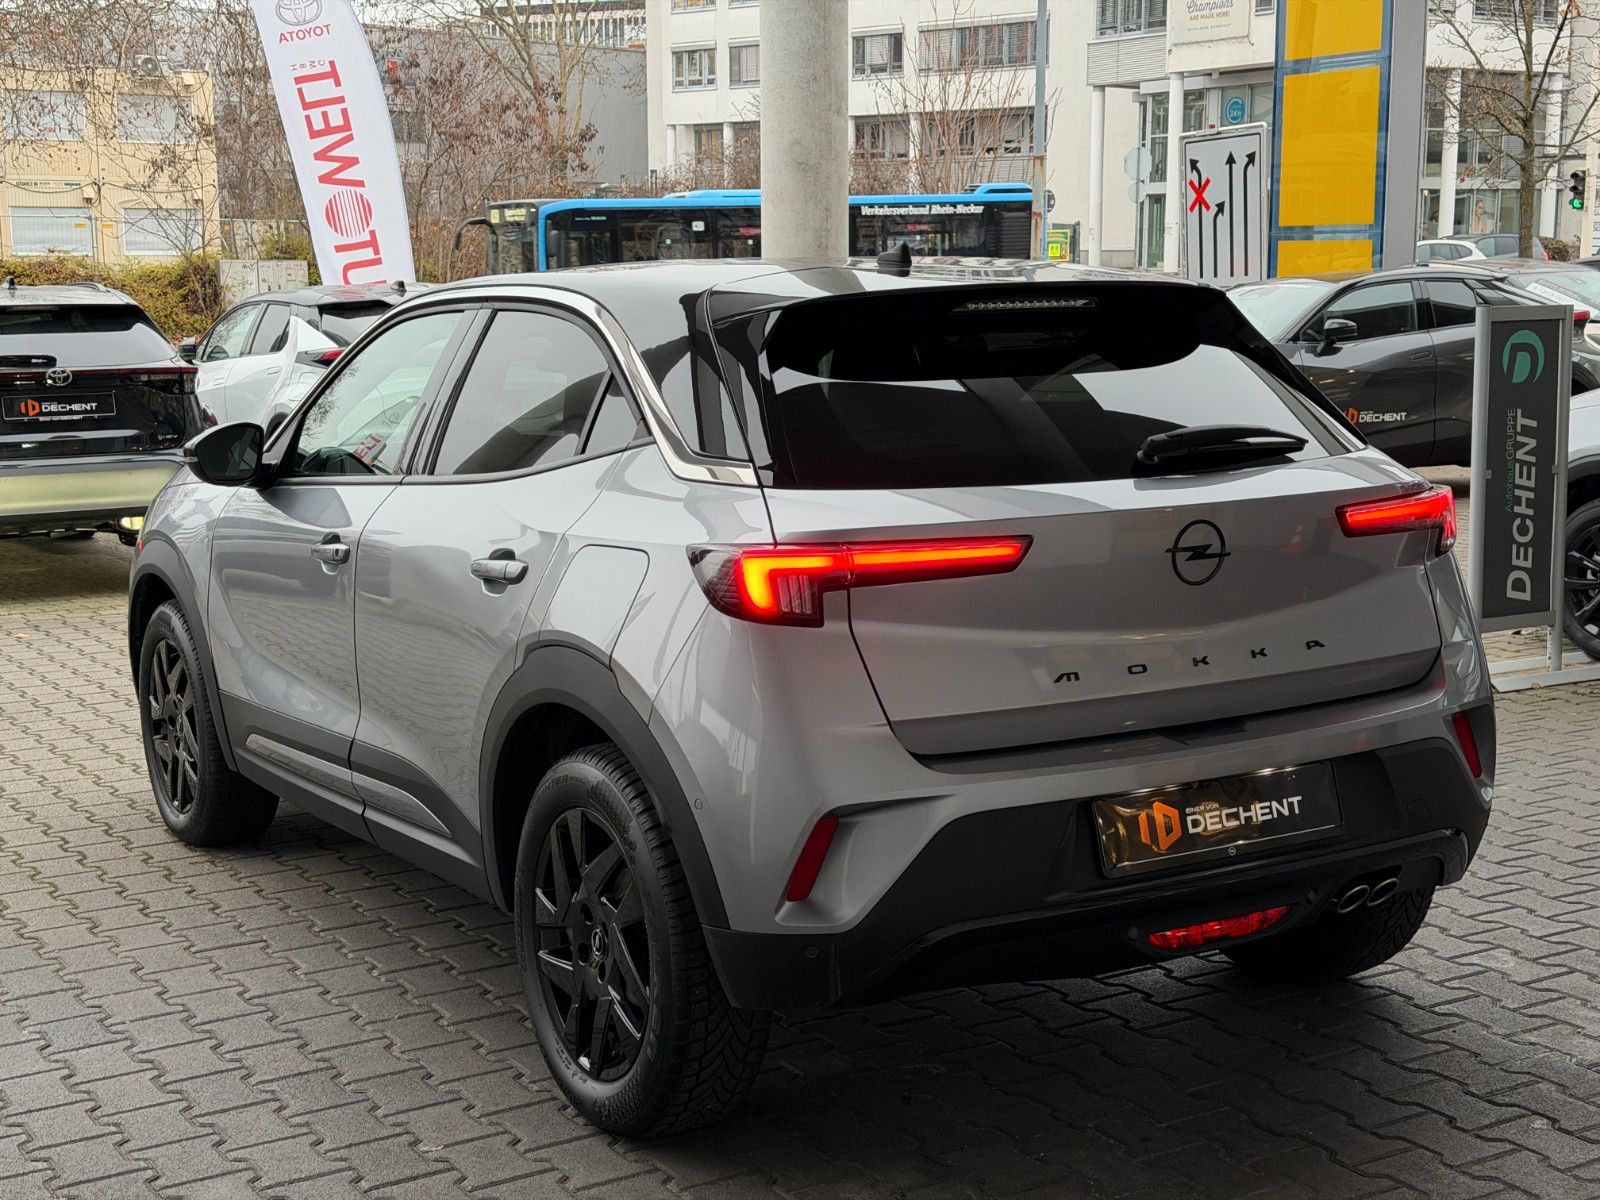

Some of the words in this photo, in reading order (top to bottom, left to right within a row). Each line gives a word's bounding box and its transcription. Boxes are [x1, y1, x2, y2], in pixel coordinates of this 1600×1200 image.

[1200, 12, 1215, 20] MADE
[860, 204, 930, 216] Verkehrsverbund
[930, 203, 985, 215] Rhein-Neckar
[41, 402, 98, 413] DECHENT
[1358, 411, 1408, 423] DECHENT
[1506, 408, 1538, 602] DECHENT
[1053, 639, 1326, 684] MOKKA
[1205, 802, 1220, 811] VON
[1186, 795, 1302, 835] DECHENT
